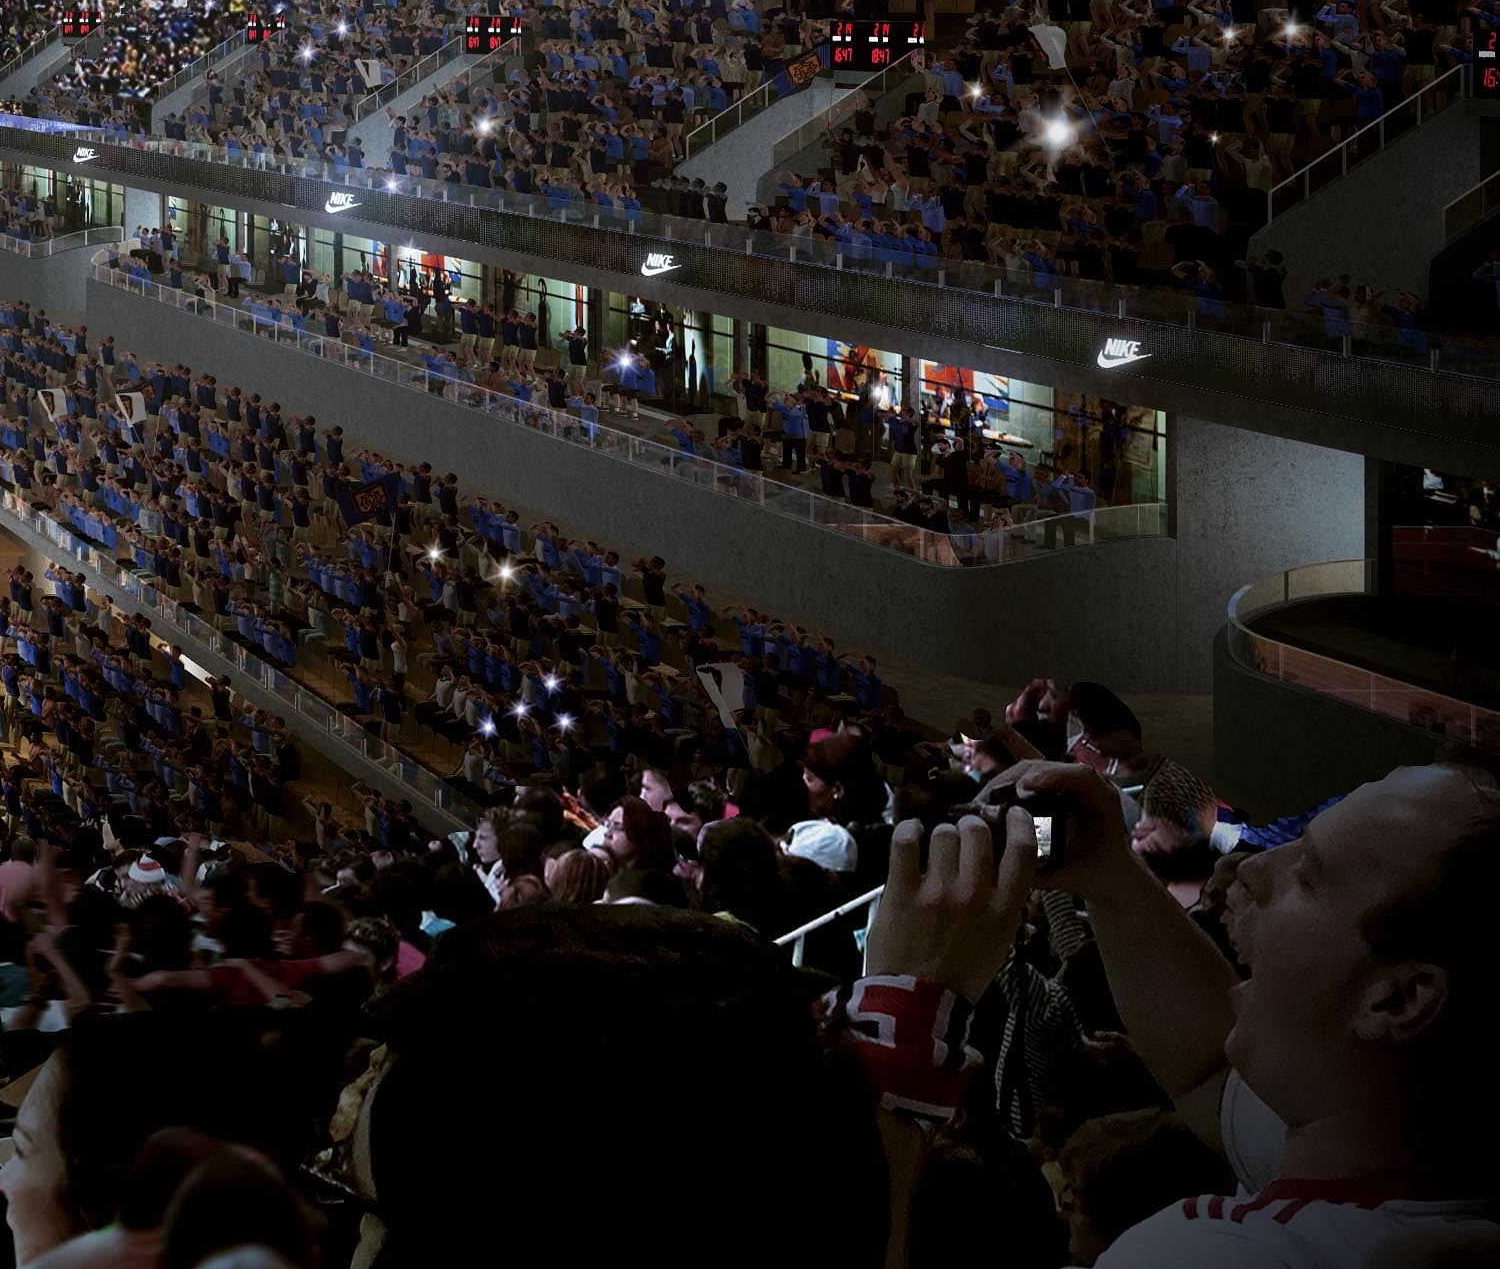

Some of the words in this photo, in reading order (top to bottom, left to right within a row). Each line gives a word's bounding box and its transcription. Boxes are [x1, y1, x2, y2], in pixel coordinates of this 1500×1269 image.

[77, 147, 95, 157] NIKE
[330, 192, 355, 205] NIKE
[646, 253, 674, 268] NIKE
[1104, 338, 1141, 357] NIKE
